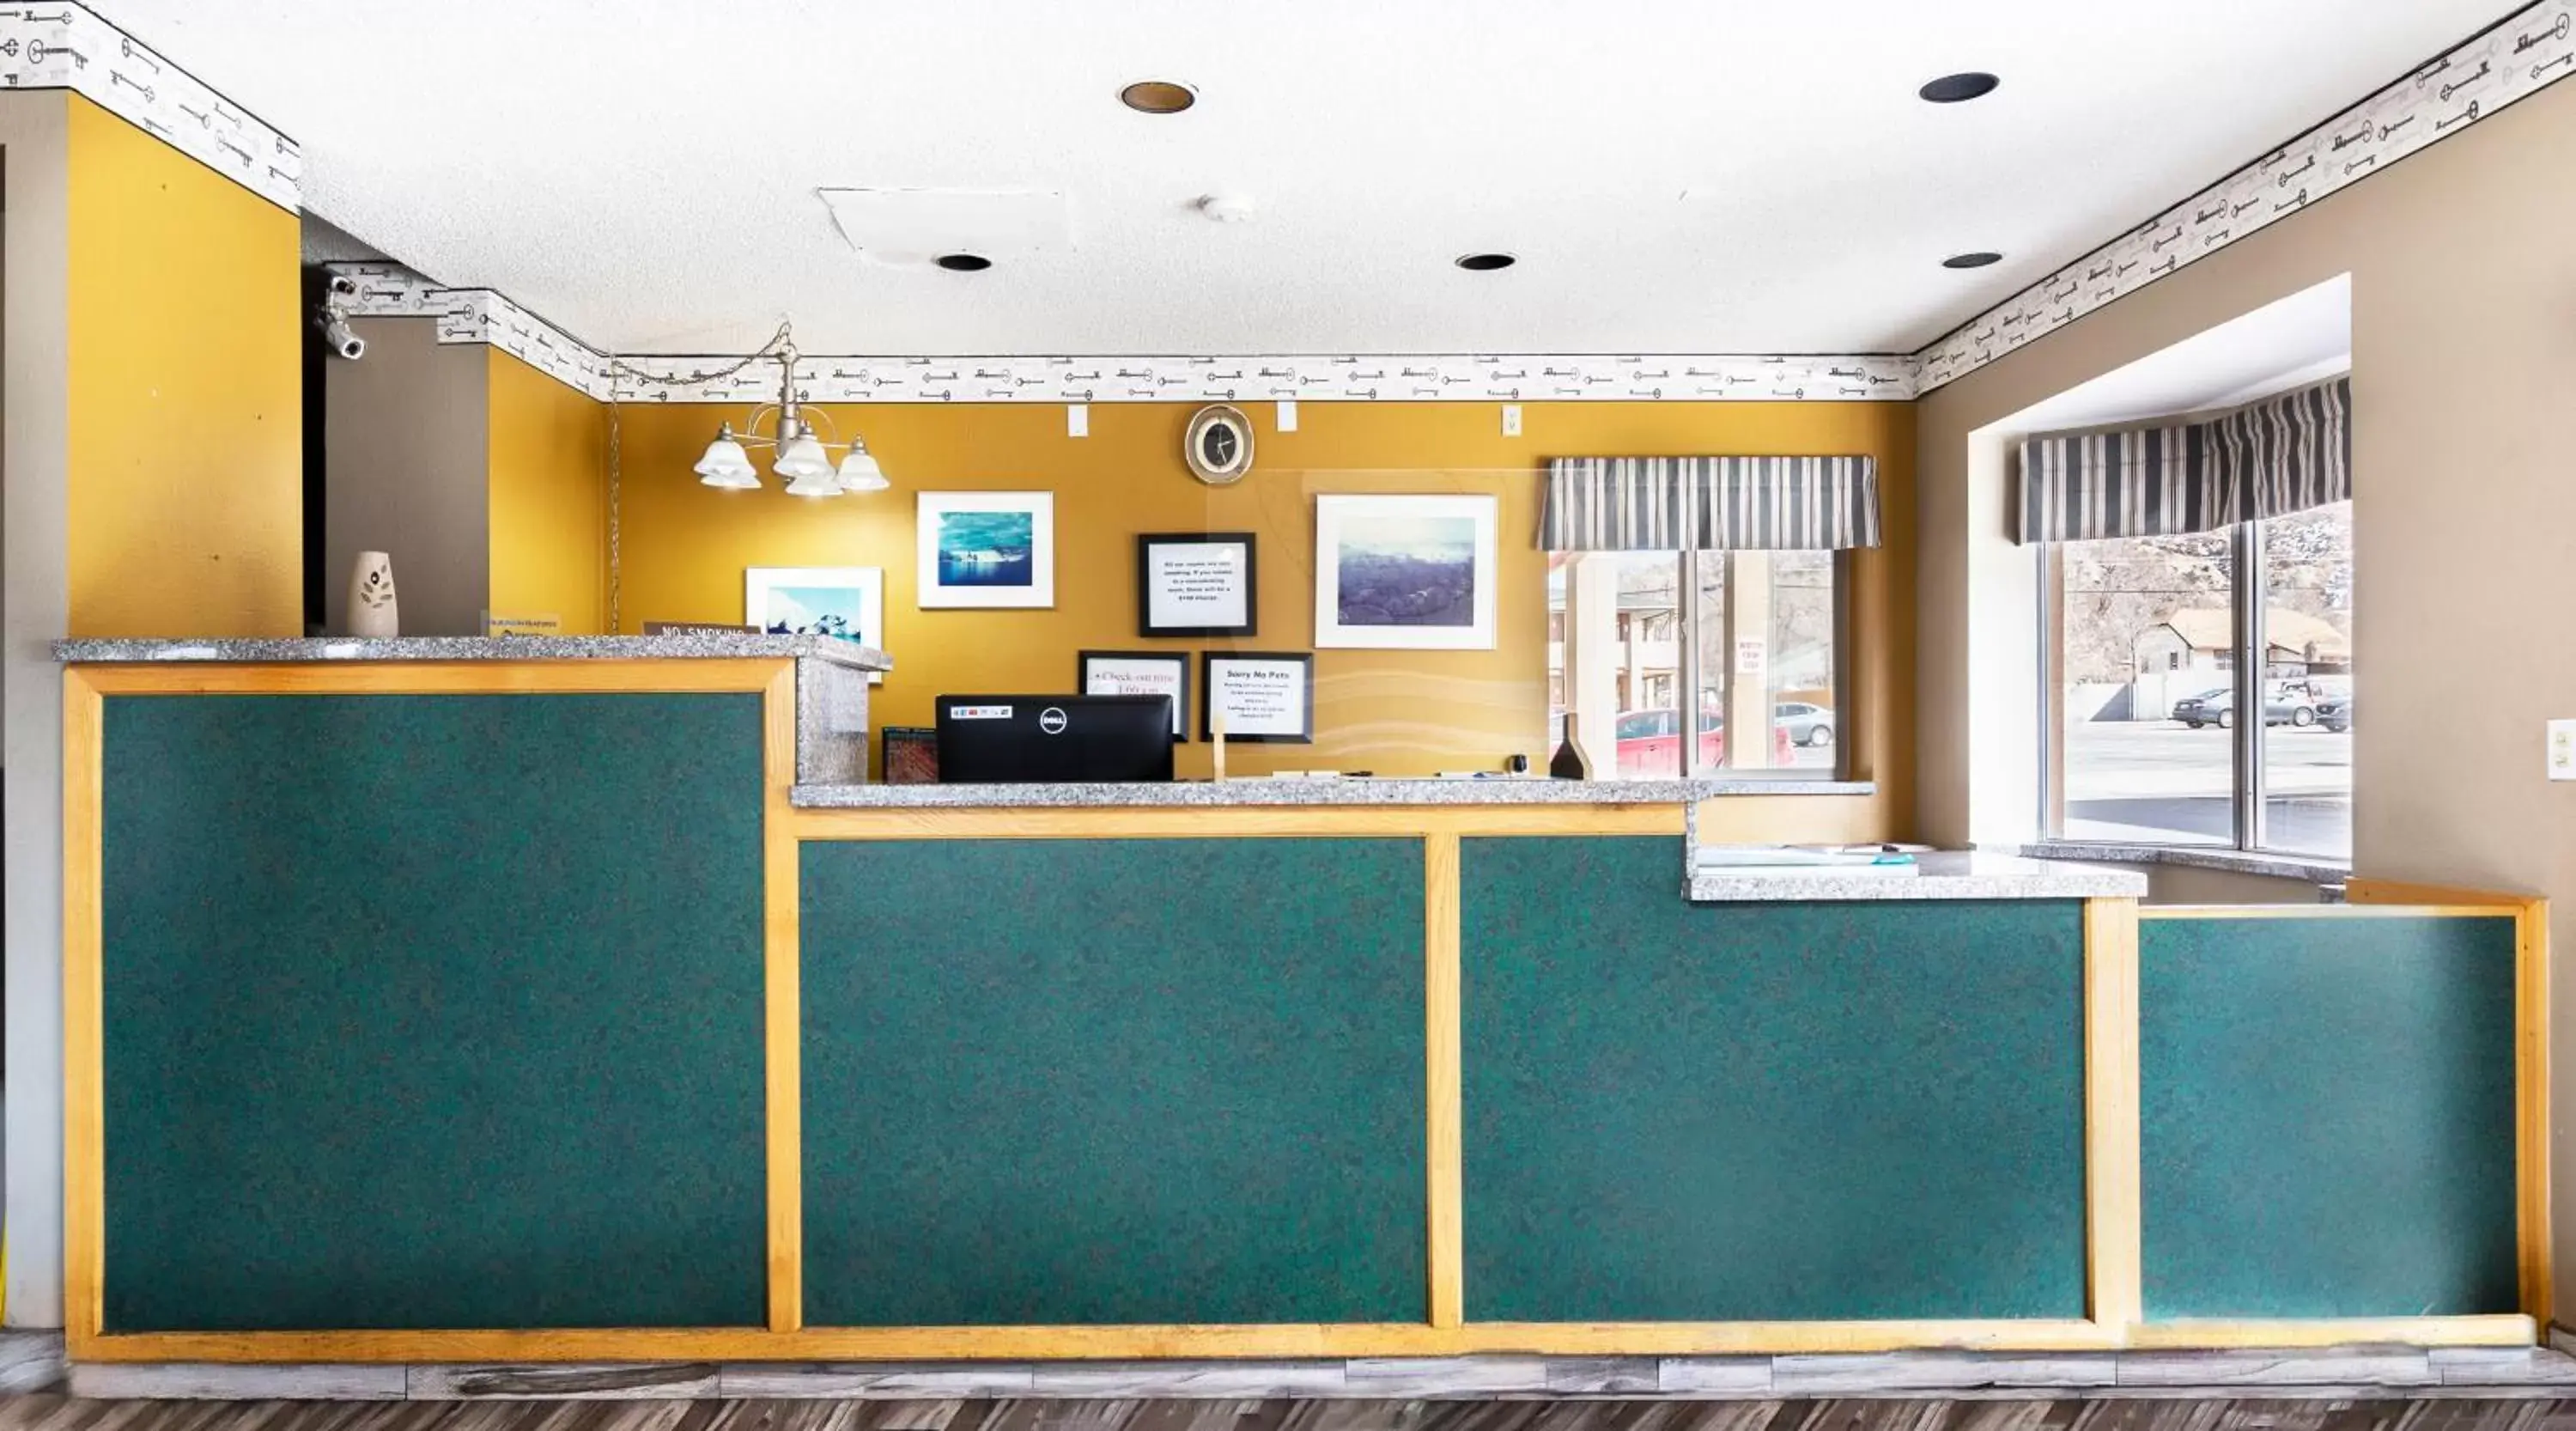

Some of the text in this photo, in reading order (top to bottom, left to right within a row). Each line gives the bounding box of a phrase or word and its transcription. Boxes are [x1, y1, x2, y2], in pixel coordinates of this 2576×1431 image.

[661, 625, 681, 636] NO
[1227, 670, 1251, 679] Sorry
[1253, 670, 1267, 679] No
